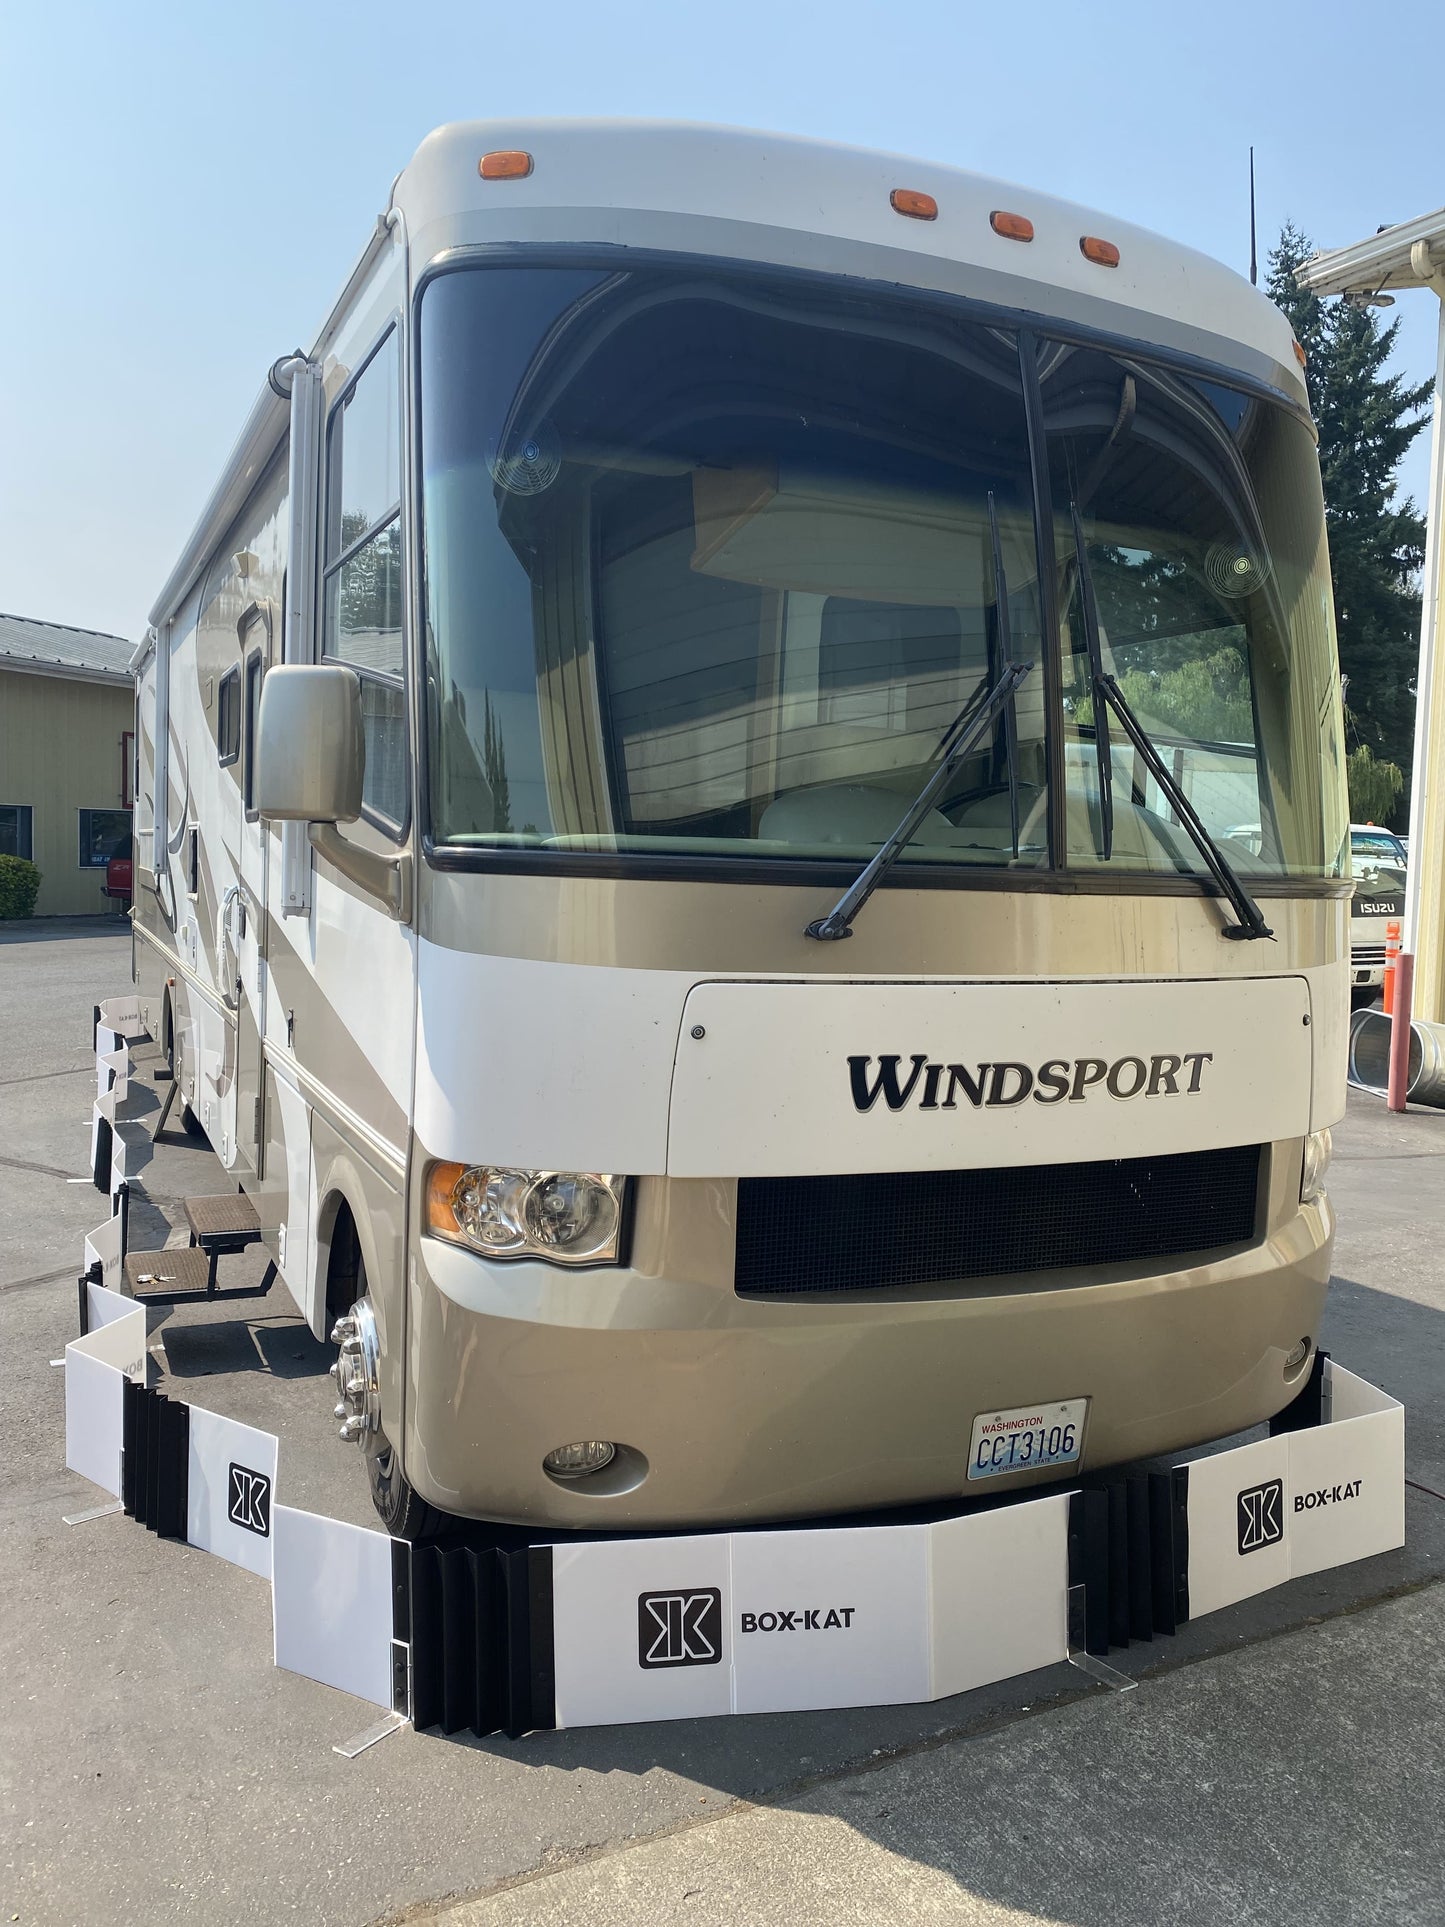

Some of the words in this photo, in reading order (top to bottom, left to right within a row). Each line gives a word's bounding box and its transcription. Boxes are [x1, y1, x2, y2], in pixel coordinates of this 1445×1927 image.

[1360, 903, 1396, 914] ISUZU
[981, 1416, 1044, 1434] WASHINGTON
[976, 1423, 1076, 1469] CCT3106
[998, 1461, 1032, 1471] EVERGREEN
[1034, 1457, 1051, 1465] STATE
[1294, 1480, 1363, 1513] BOX-KAT
[741, 1607, 856, 1634] BOX-KAT
